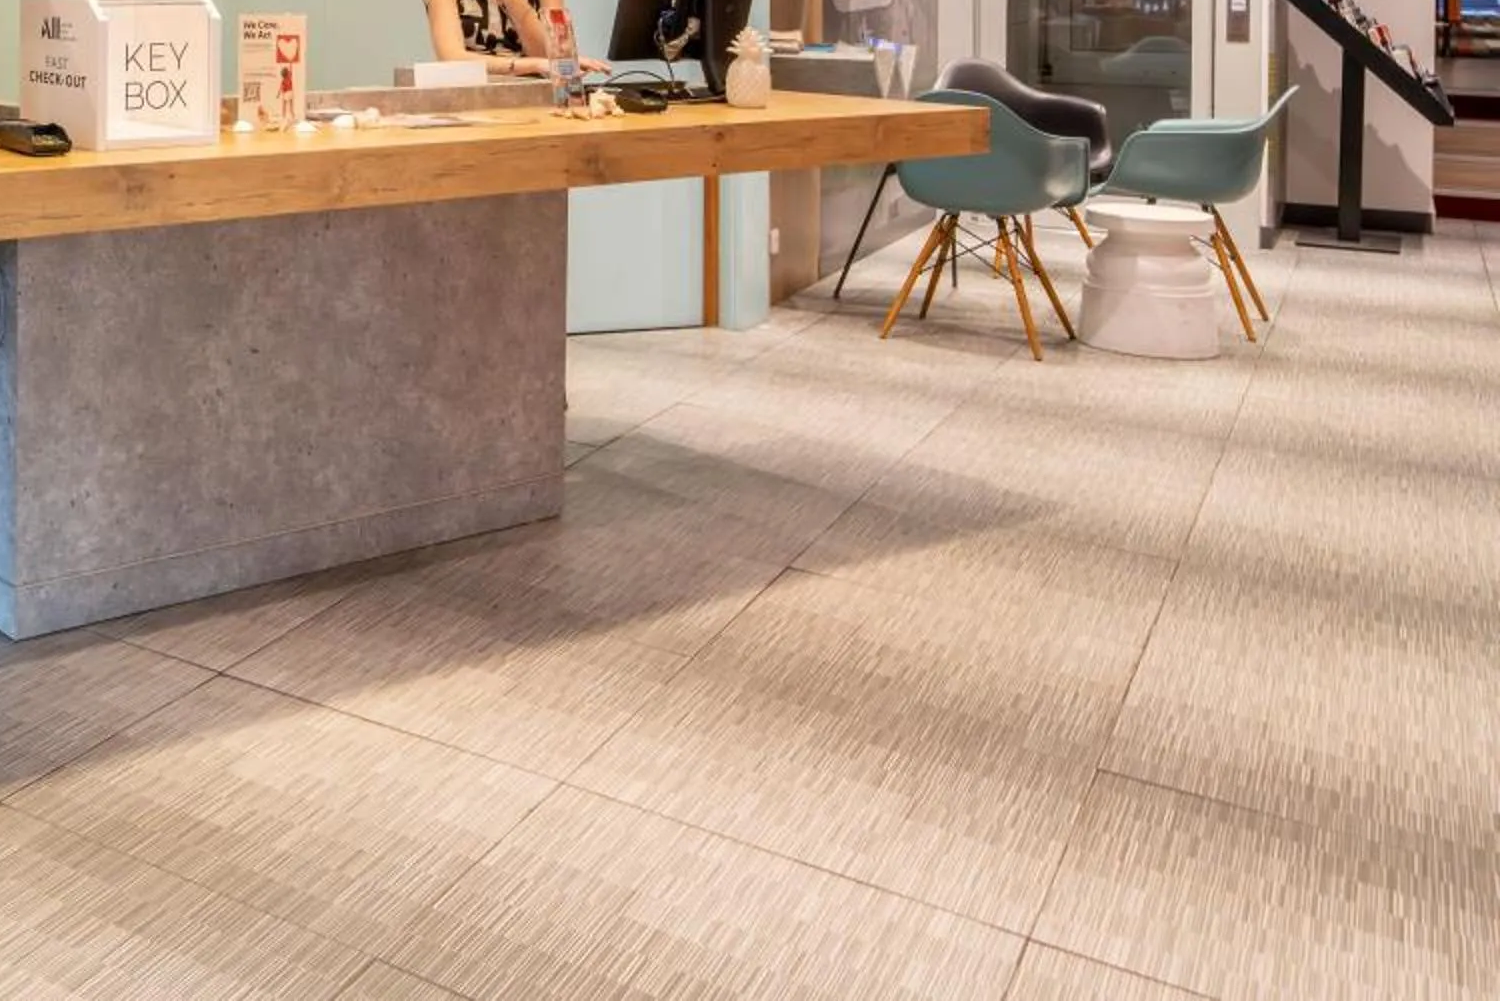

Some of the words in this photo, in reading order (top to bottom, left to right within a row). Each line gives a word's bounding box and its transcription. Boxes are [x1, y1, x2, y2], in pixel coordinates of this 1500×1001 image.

[45, 55, 69, 70] FAST
[124, 41, 189, 73] KEY
[124, 80, 188, 111] BOX
